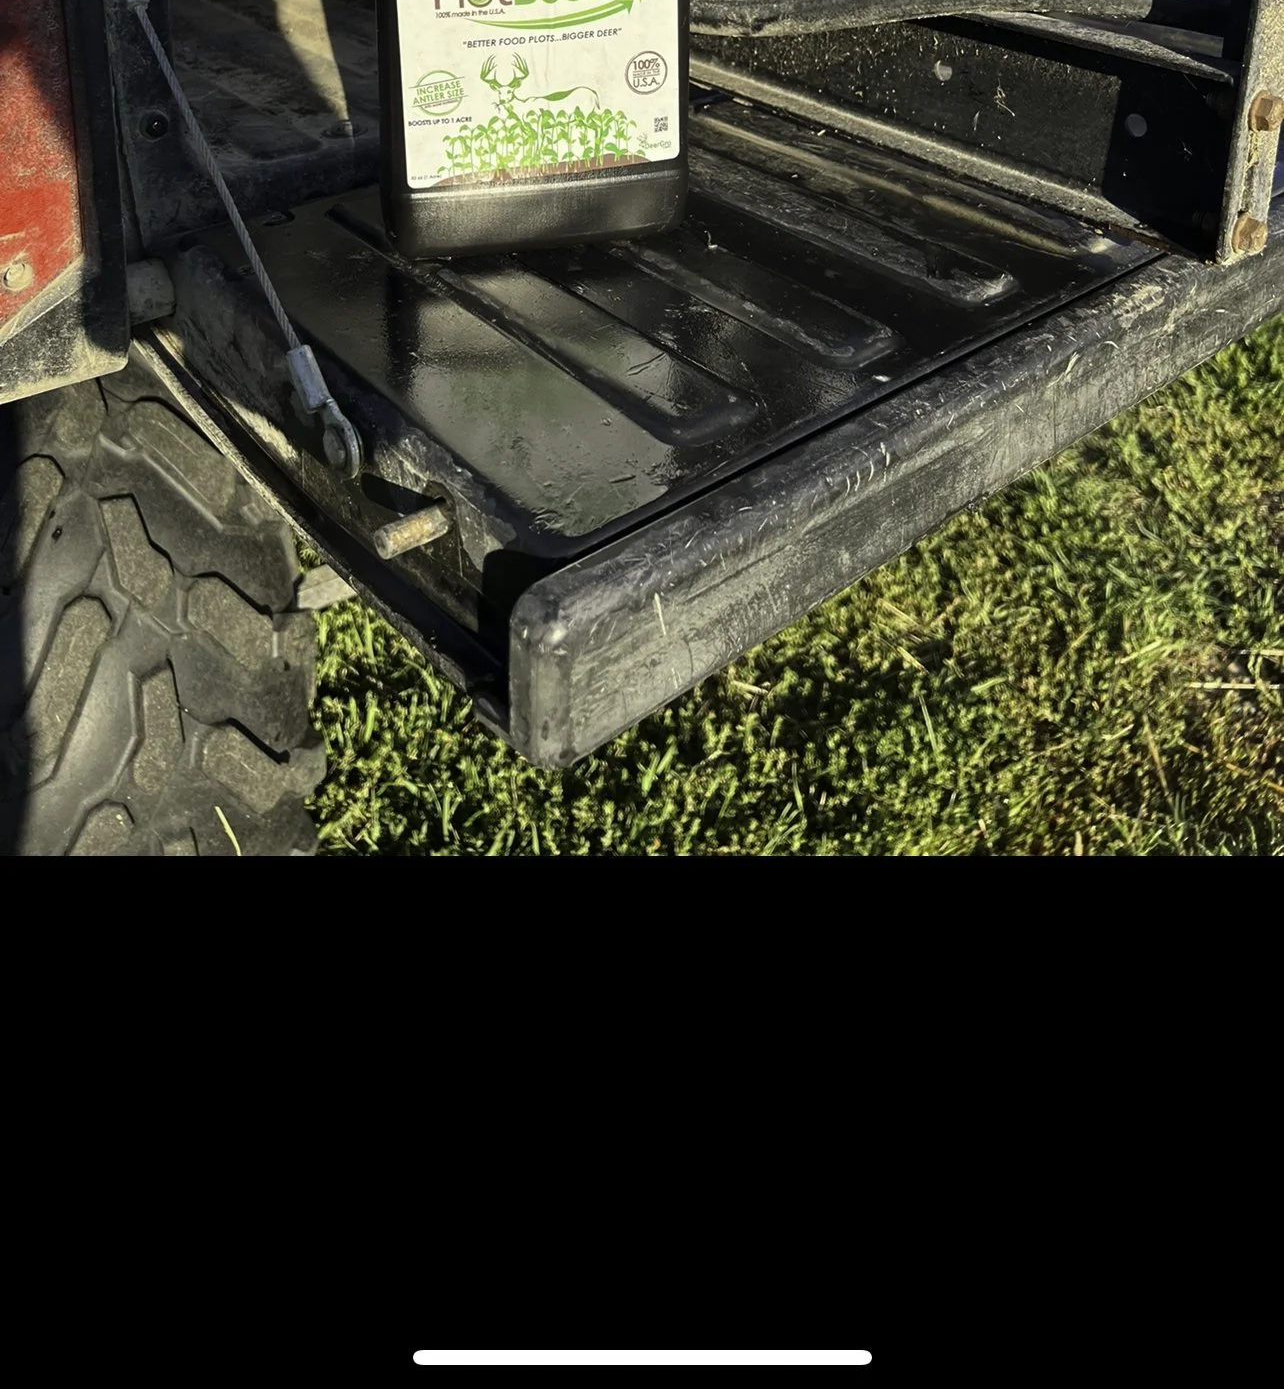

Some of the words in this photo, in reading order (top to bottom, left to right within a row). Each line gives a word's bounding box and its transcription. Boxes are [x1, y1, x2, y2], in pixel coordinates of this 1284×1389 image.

[435, 11, 451, 19] 100%
[463, 38, 497, 48] "BETTER
[499, 36, 526, 46] FOOD
[597, 28, 622, 37] DEER"
[633, 58, 660, 70] 100%
[416, 80, 461, 96] INCREASE
[633, 77, 660, 88] U.S.A.
[413, 92, 445, 105] ANTLER
[448, 88, 465, 99] SIZE
